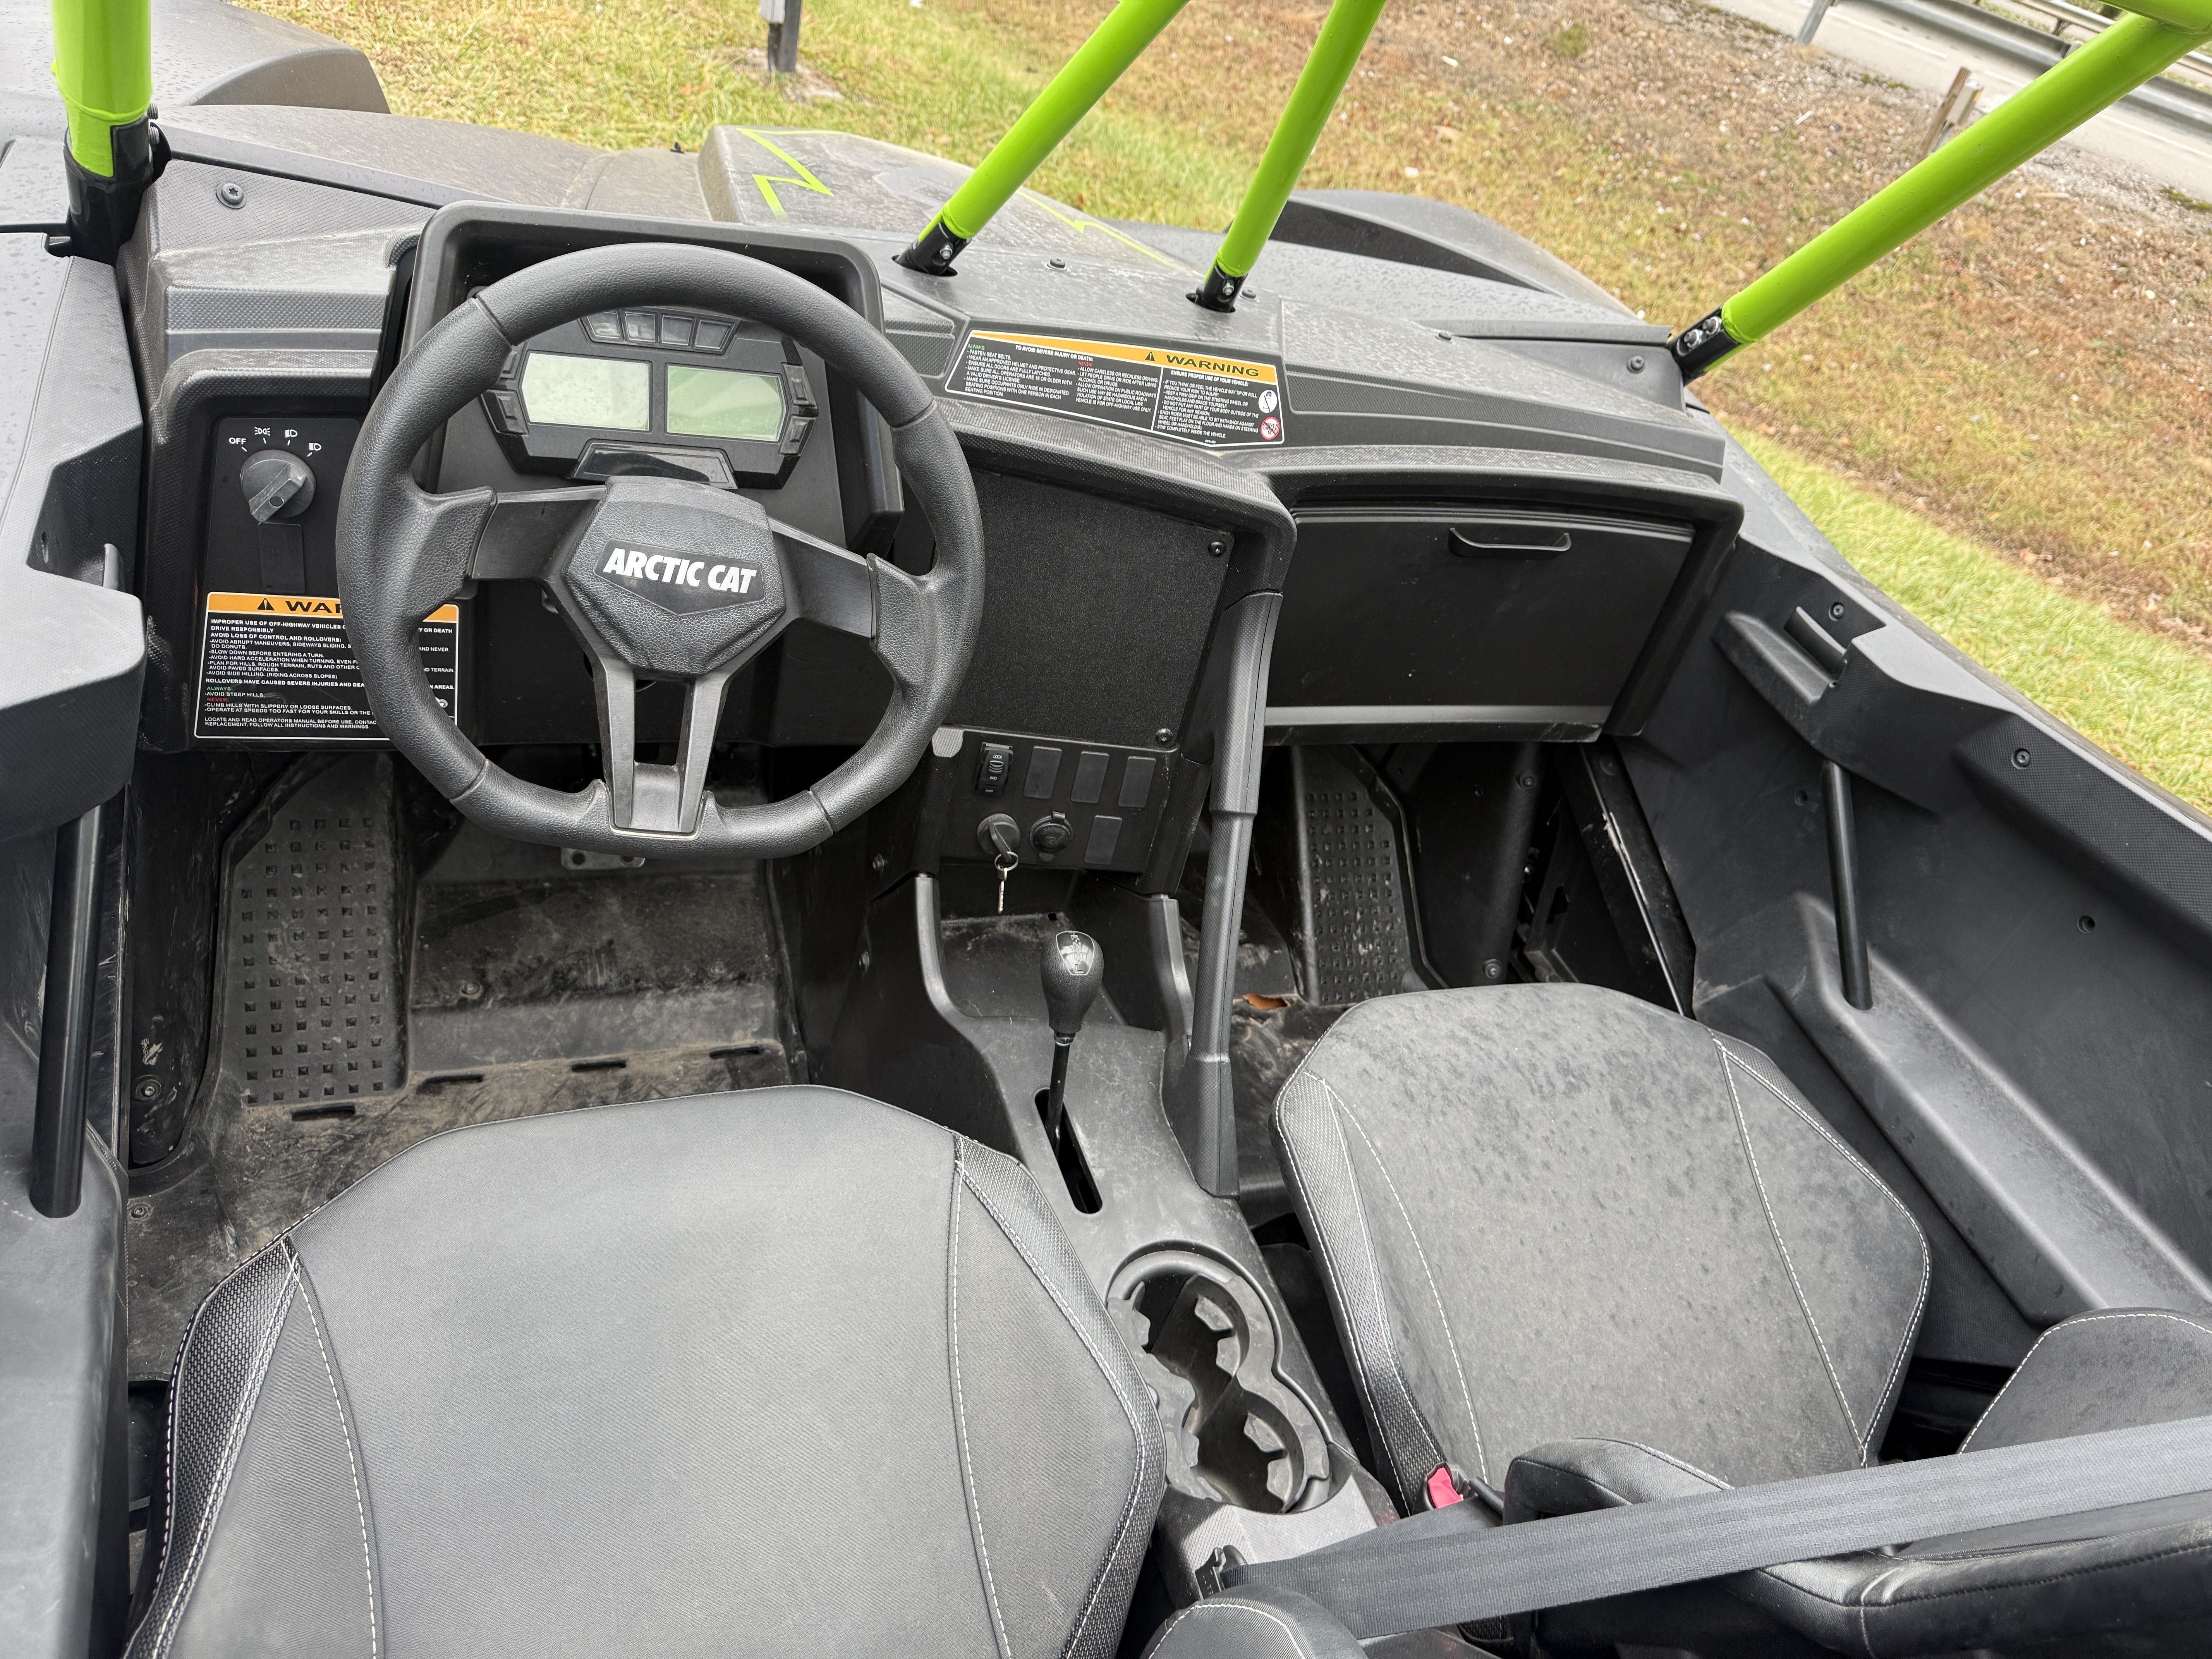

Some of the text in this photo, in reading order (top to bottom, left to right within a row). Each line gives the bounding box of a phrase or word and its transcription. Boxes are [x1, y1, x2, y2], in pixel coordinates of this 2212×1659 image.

[1166, 355, 1259, 376] WARNING
[228, 437, 246, 445] OFF
[603, 548, 757, 594] ARCTIC CAT
